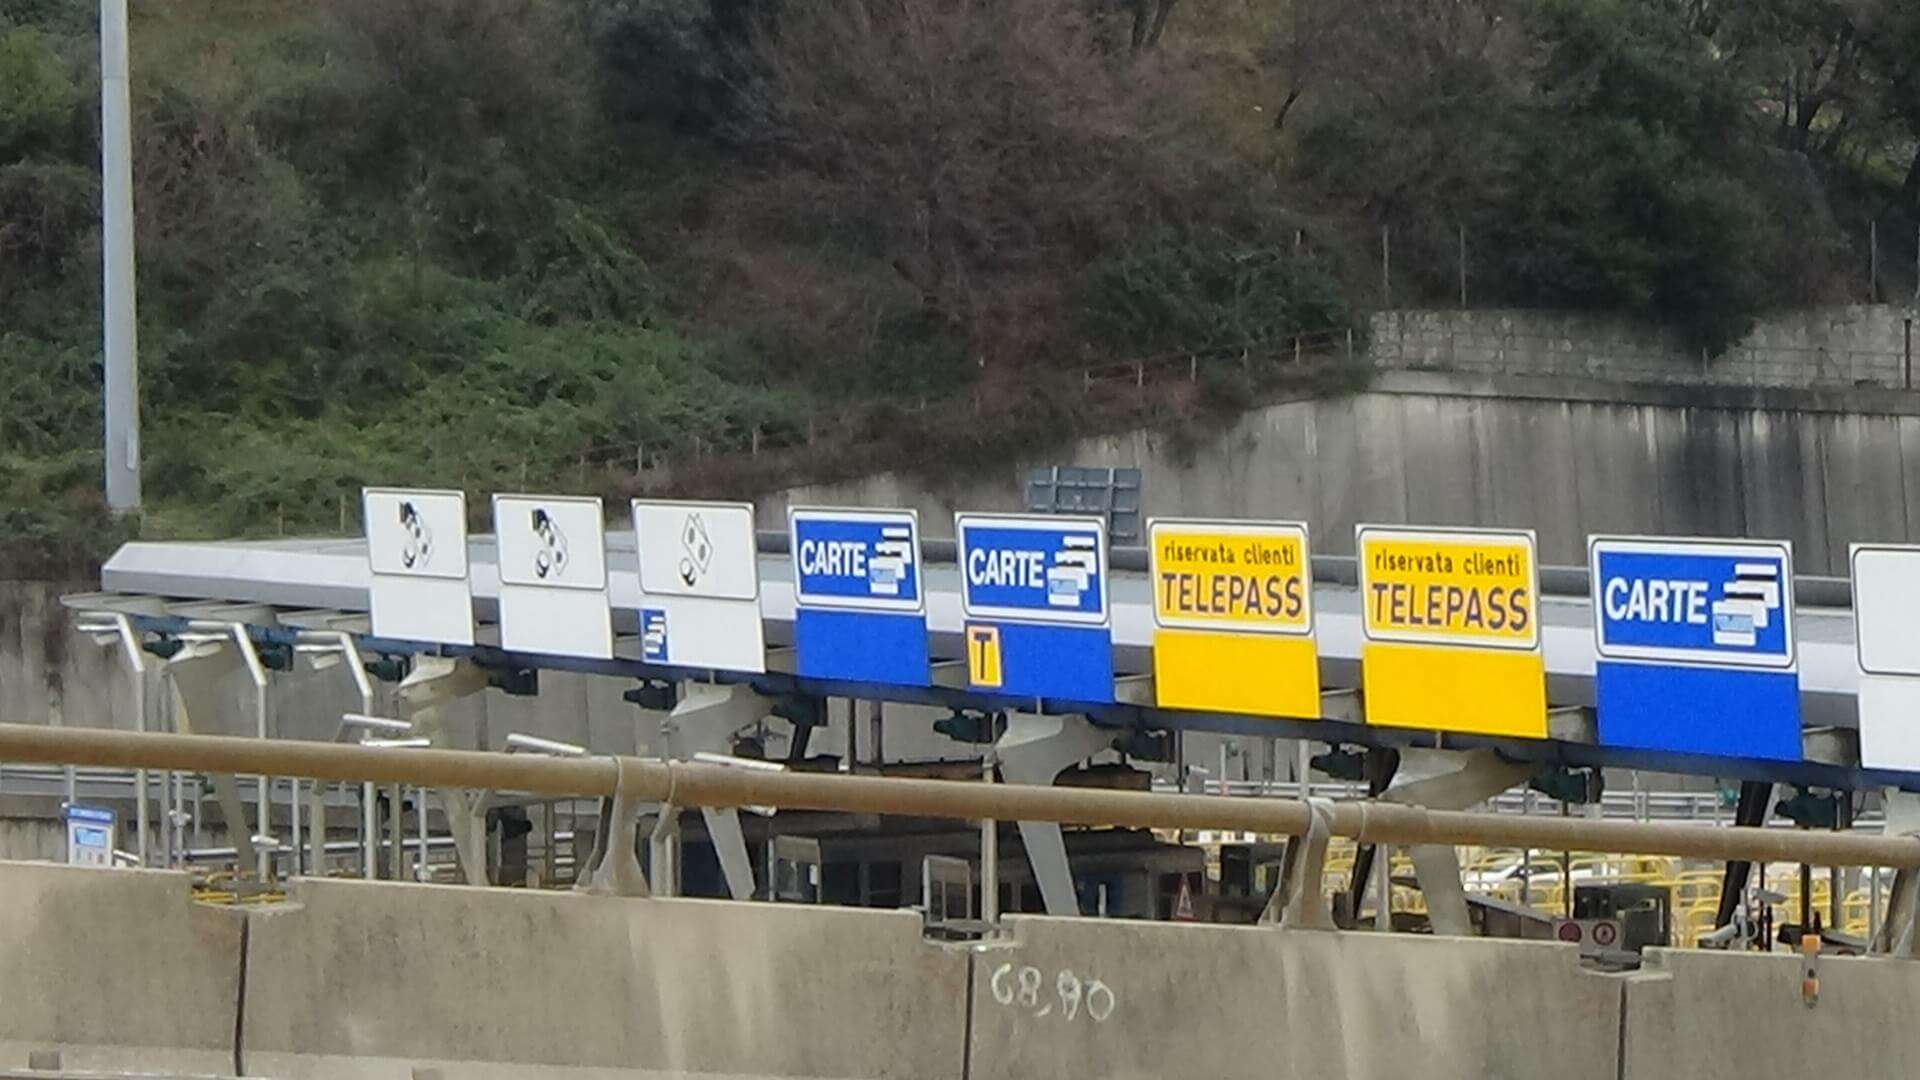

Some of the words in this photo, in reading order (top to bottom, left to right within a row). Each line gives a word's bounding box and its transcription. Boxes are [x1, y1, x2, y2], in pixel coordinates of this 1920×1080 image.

[799, 540, 866, 577] CARTE
[968, 548, 1044, 588] CARTE
[1164, 541, 1235, 564] riservata
[1243, 544, 1295, 566] clienti
[1375, 549, 1453, 574] riservata
[1463, 551, 1520, 577] clienti
[1162, 573, 1301, 618] TELEPASS
[1372, 583, 1528, 631] TELEPASS
[1605, 577, 1709, 624] CARTE
[973, 632, 993, 680] T
